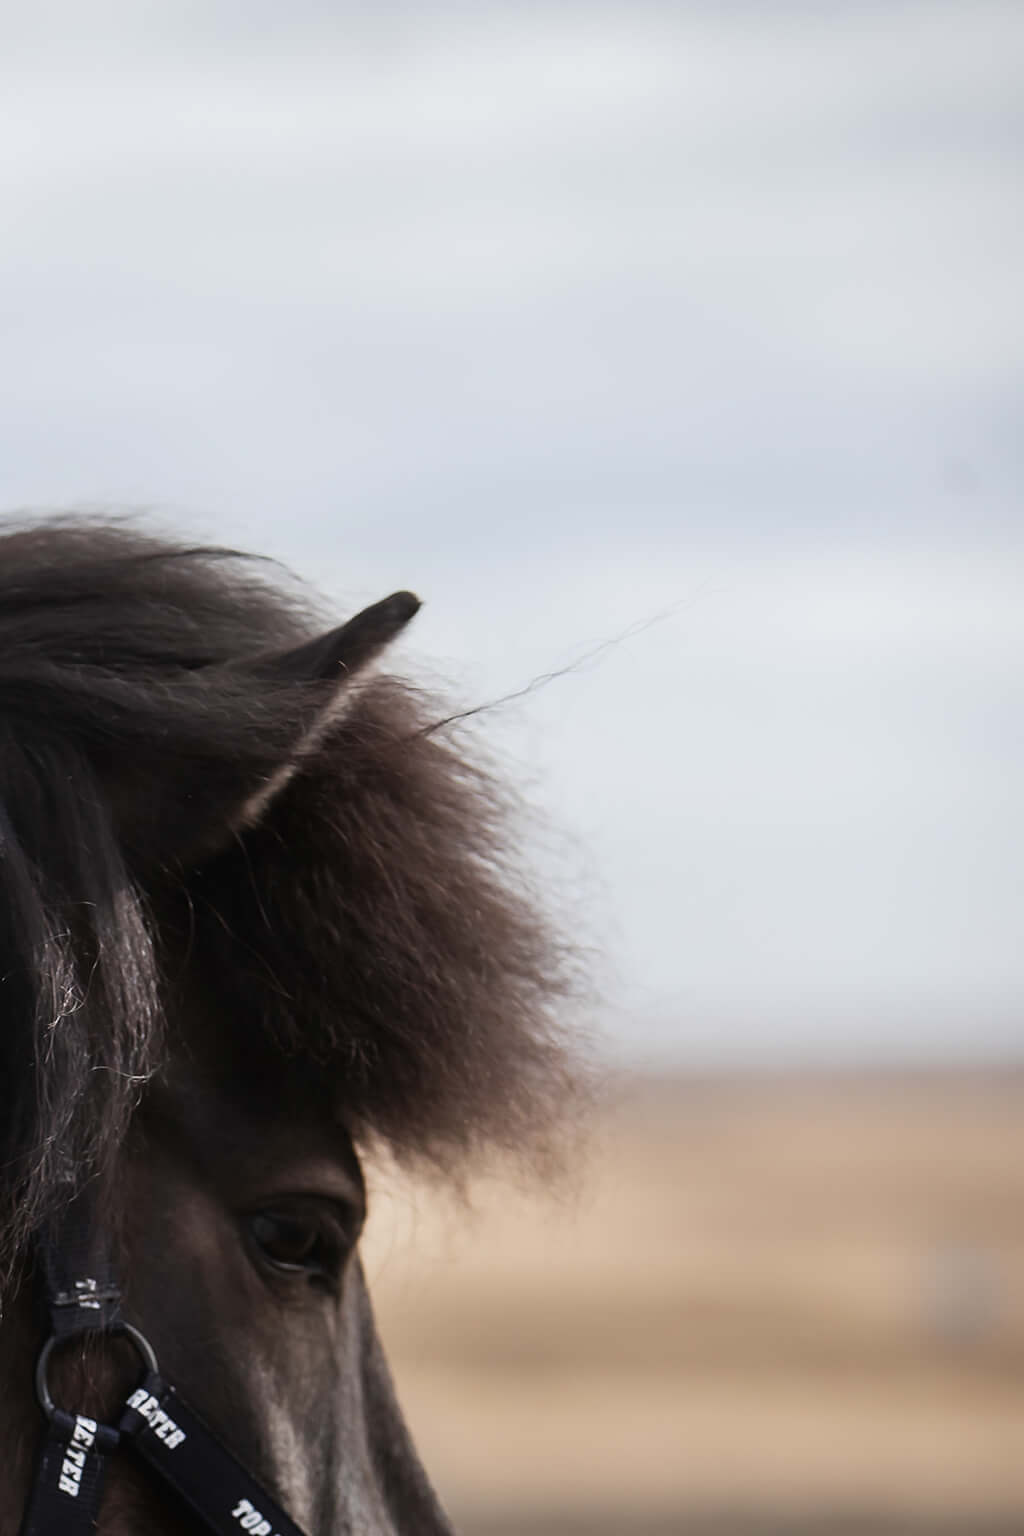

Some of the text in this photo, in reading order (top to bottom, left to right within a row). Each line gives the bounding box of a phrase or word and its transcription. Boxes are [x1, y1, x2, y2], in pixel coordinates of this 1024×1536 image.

[126, 1388, 187, 1450] REITER
[58, 1415, 98, 1497] REITER
[231, 1498, 272, 1536] TOP
